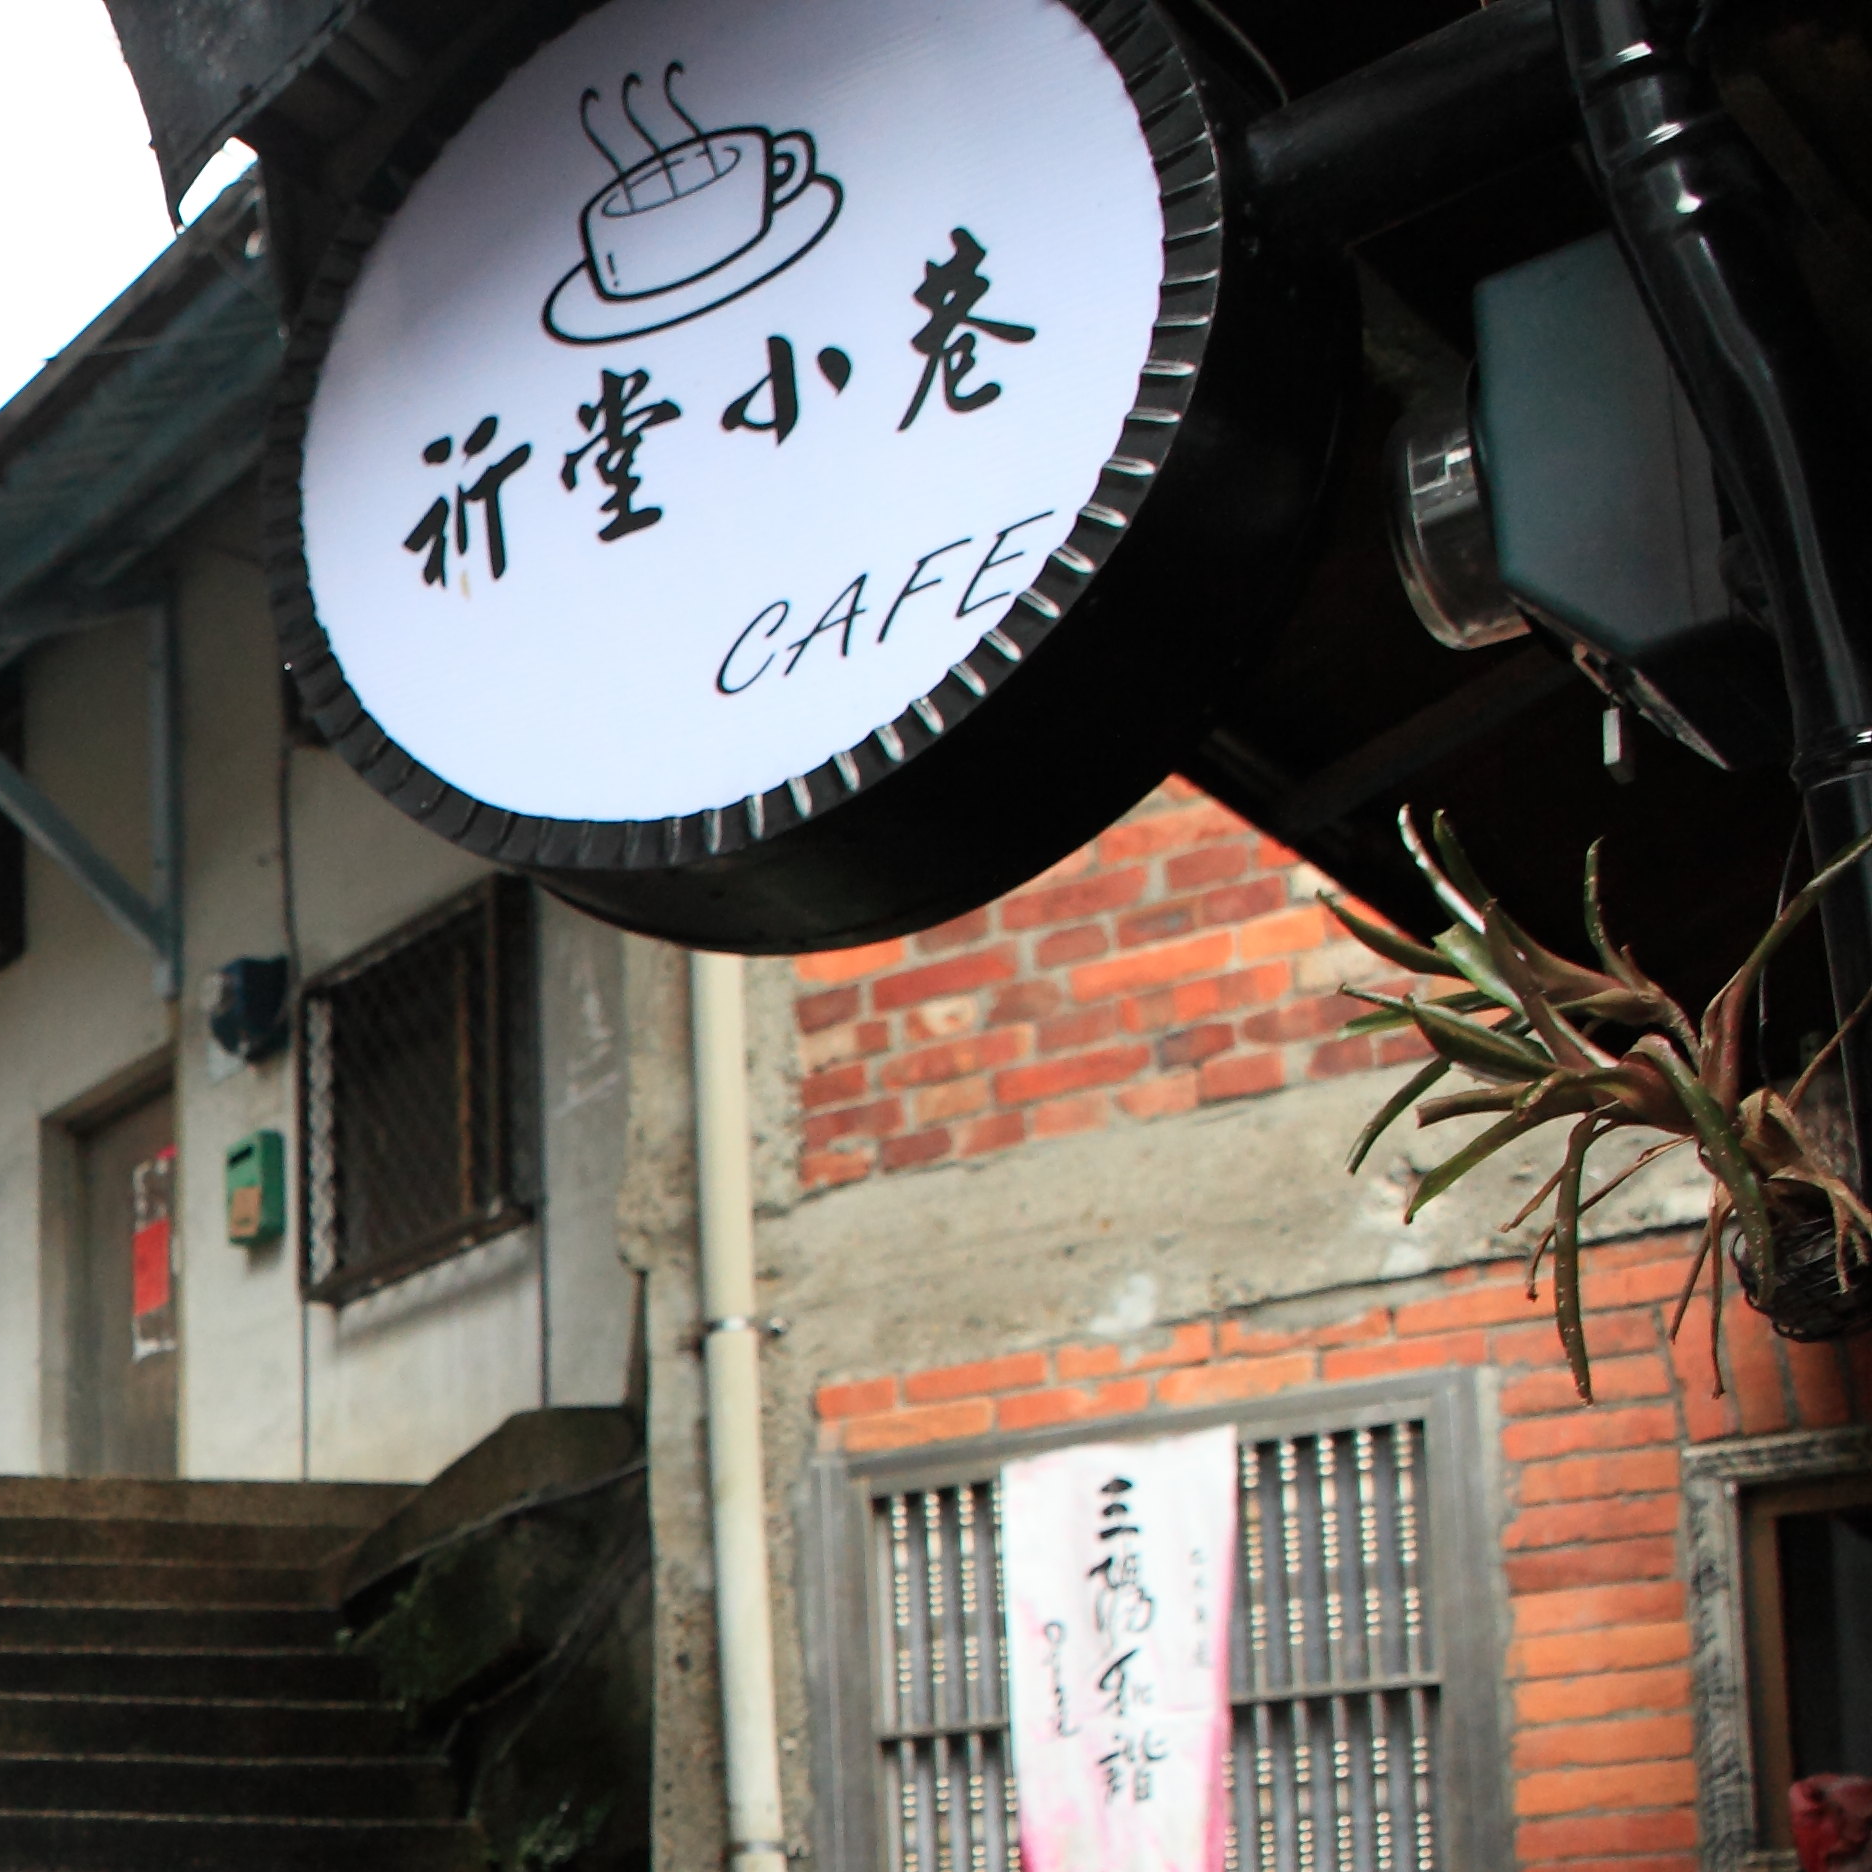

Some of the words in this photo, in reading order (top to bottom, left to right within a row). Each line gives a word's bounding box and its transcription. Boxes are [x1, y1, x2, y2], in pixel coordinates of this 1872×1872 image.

[402, 226, 1037, 588] 祈堂小巷
[715, 510, 1054, 696] CAFE
